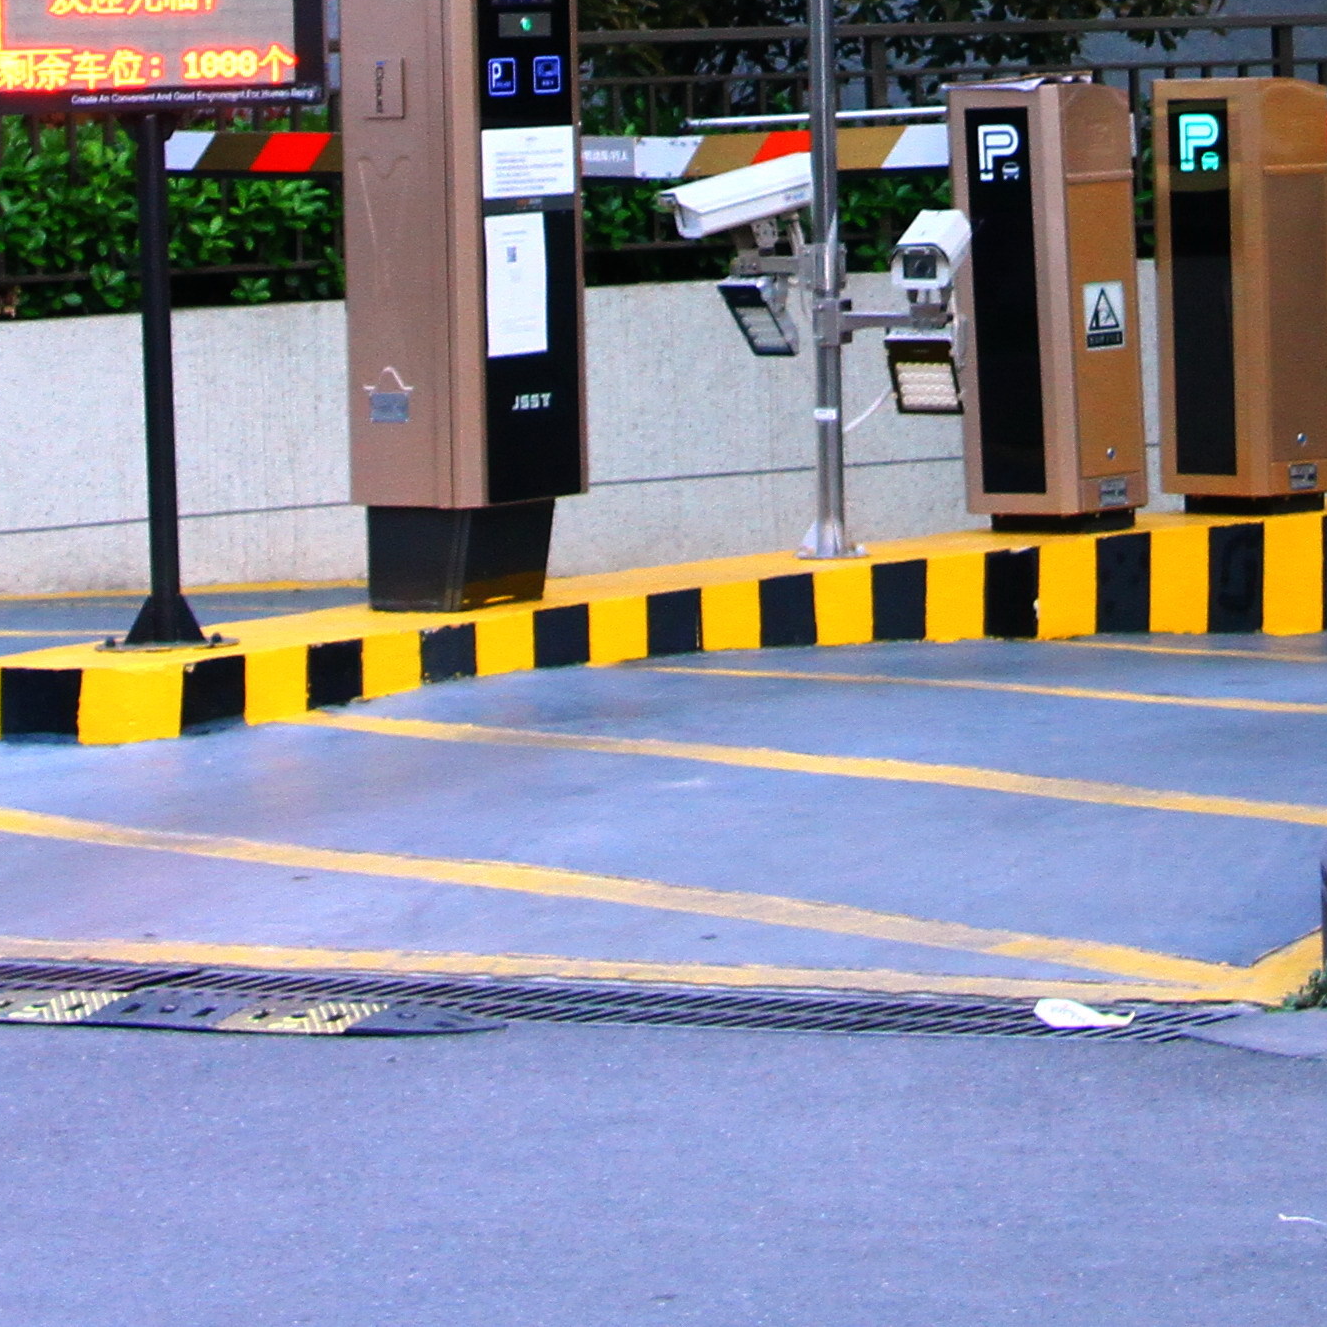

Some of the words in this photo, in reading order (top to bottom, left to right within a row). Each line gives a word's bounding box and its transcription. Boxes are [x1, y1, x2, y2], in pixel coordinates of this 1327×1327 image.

[99, 94, 110, 104] An
[156, 91, 172, 102] And
[173, 90, 195, 101] Good
